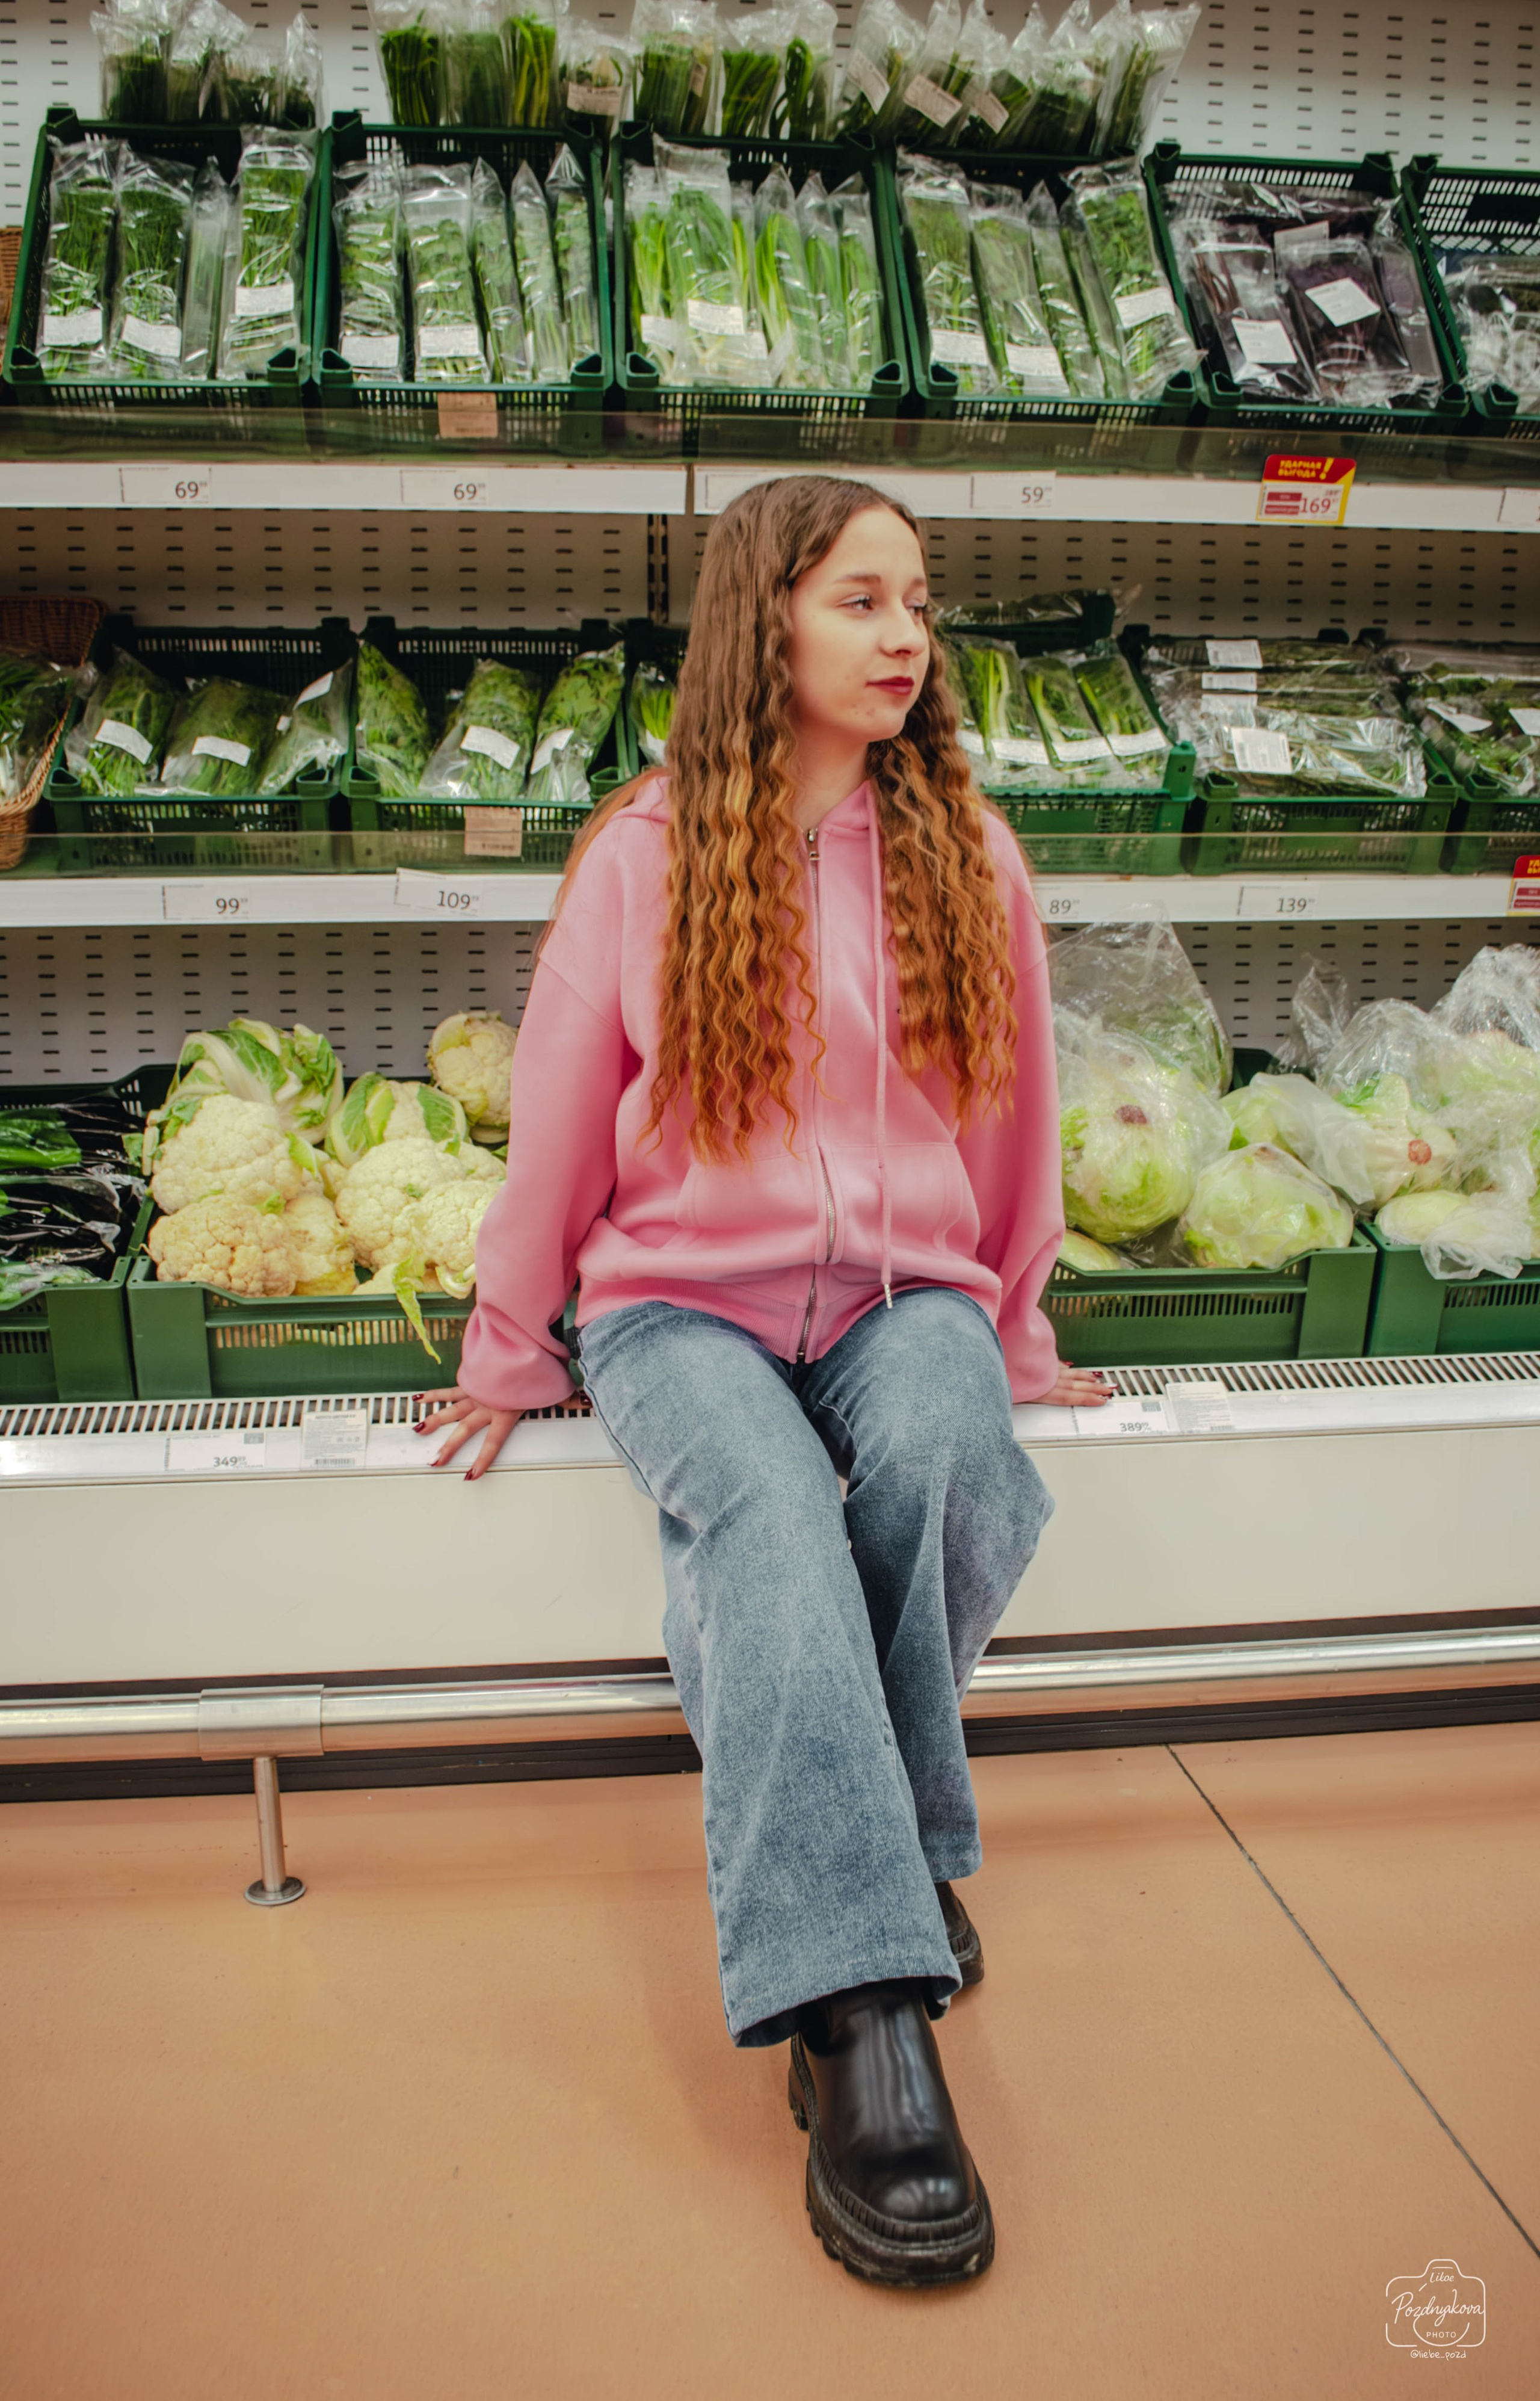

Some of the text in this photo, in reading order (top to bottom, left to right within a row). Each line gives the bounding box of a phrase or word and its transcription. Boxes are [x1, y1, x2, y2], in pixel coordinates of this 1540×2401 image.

[176, 481, 199, 499] 69
[454, 483, 477, 501] 69
[1021, 486, 1043, 504] 59
[1301, 497, 1331, 514] 169
[216, 898, 239, 915] 99
[437, 890, 470, 910] 109
[1050, 899, 1071, 915] 89
[1276, 897, 1307, 913] 139
[1119, 1422, 1142, 1433] 389
[213, 1456, 238, 1468] 349
